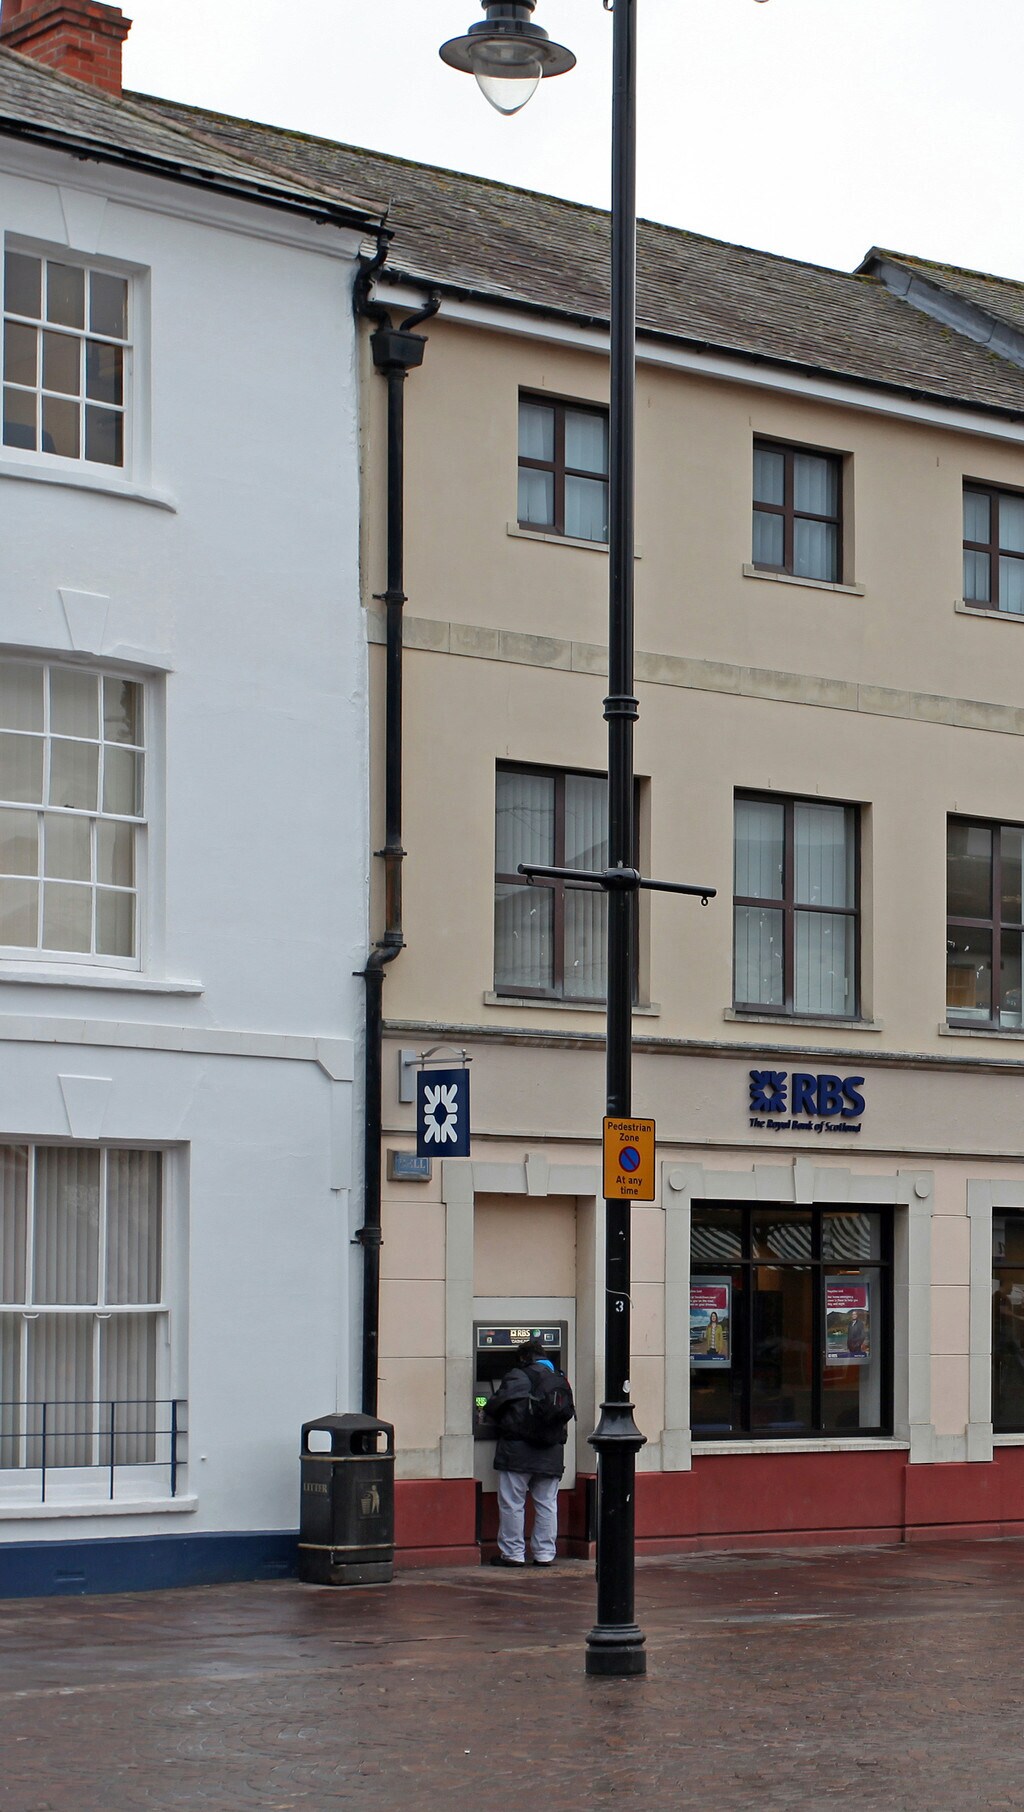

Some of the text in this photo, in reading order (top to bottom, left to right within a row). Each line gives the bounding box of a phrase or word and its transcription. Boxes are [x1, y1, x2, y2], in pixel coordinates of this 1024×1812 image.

[791, 1073, 866, 1117] RBS
[607, 1121, 652, 1132] Pedestrian
[749, 1118, 862, 1134] The Royal Bank of Scotland
[619, 1133, 640, 1141] Zone
[616, 1175, 643, 1186] At any
[620, 1186, 639, 1195] time
[615, 1301, 624, 1312] 3
[303, 1483, 328, 1493] LITTER
